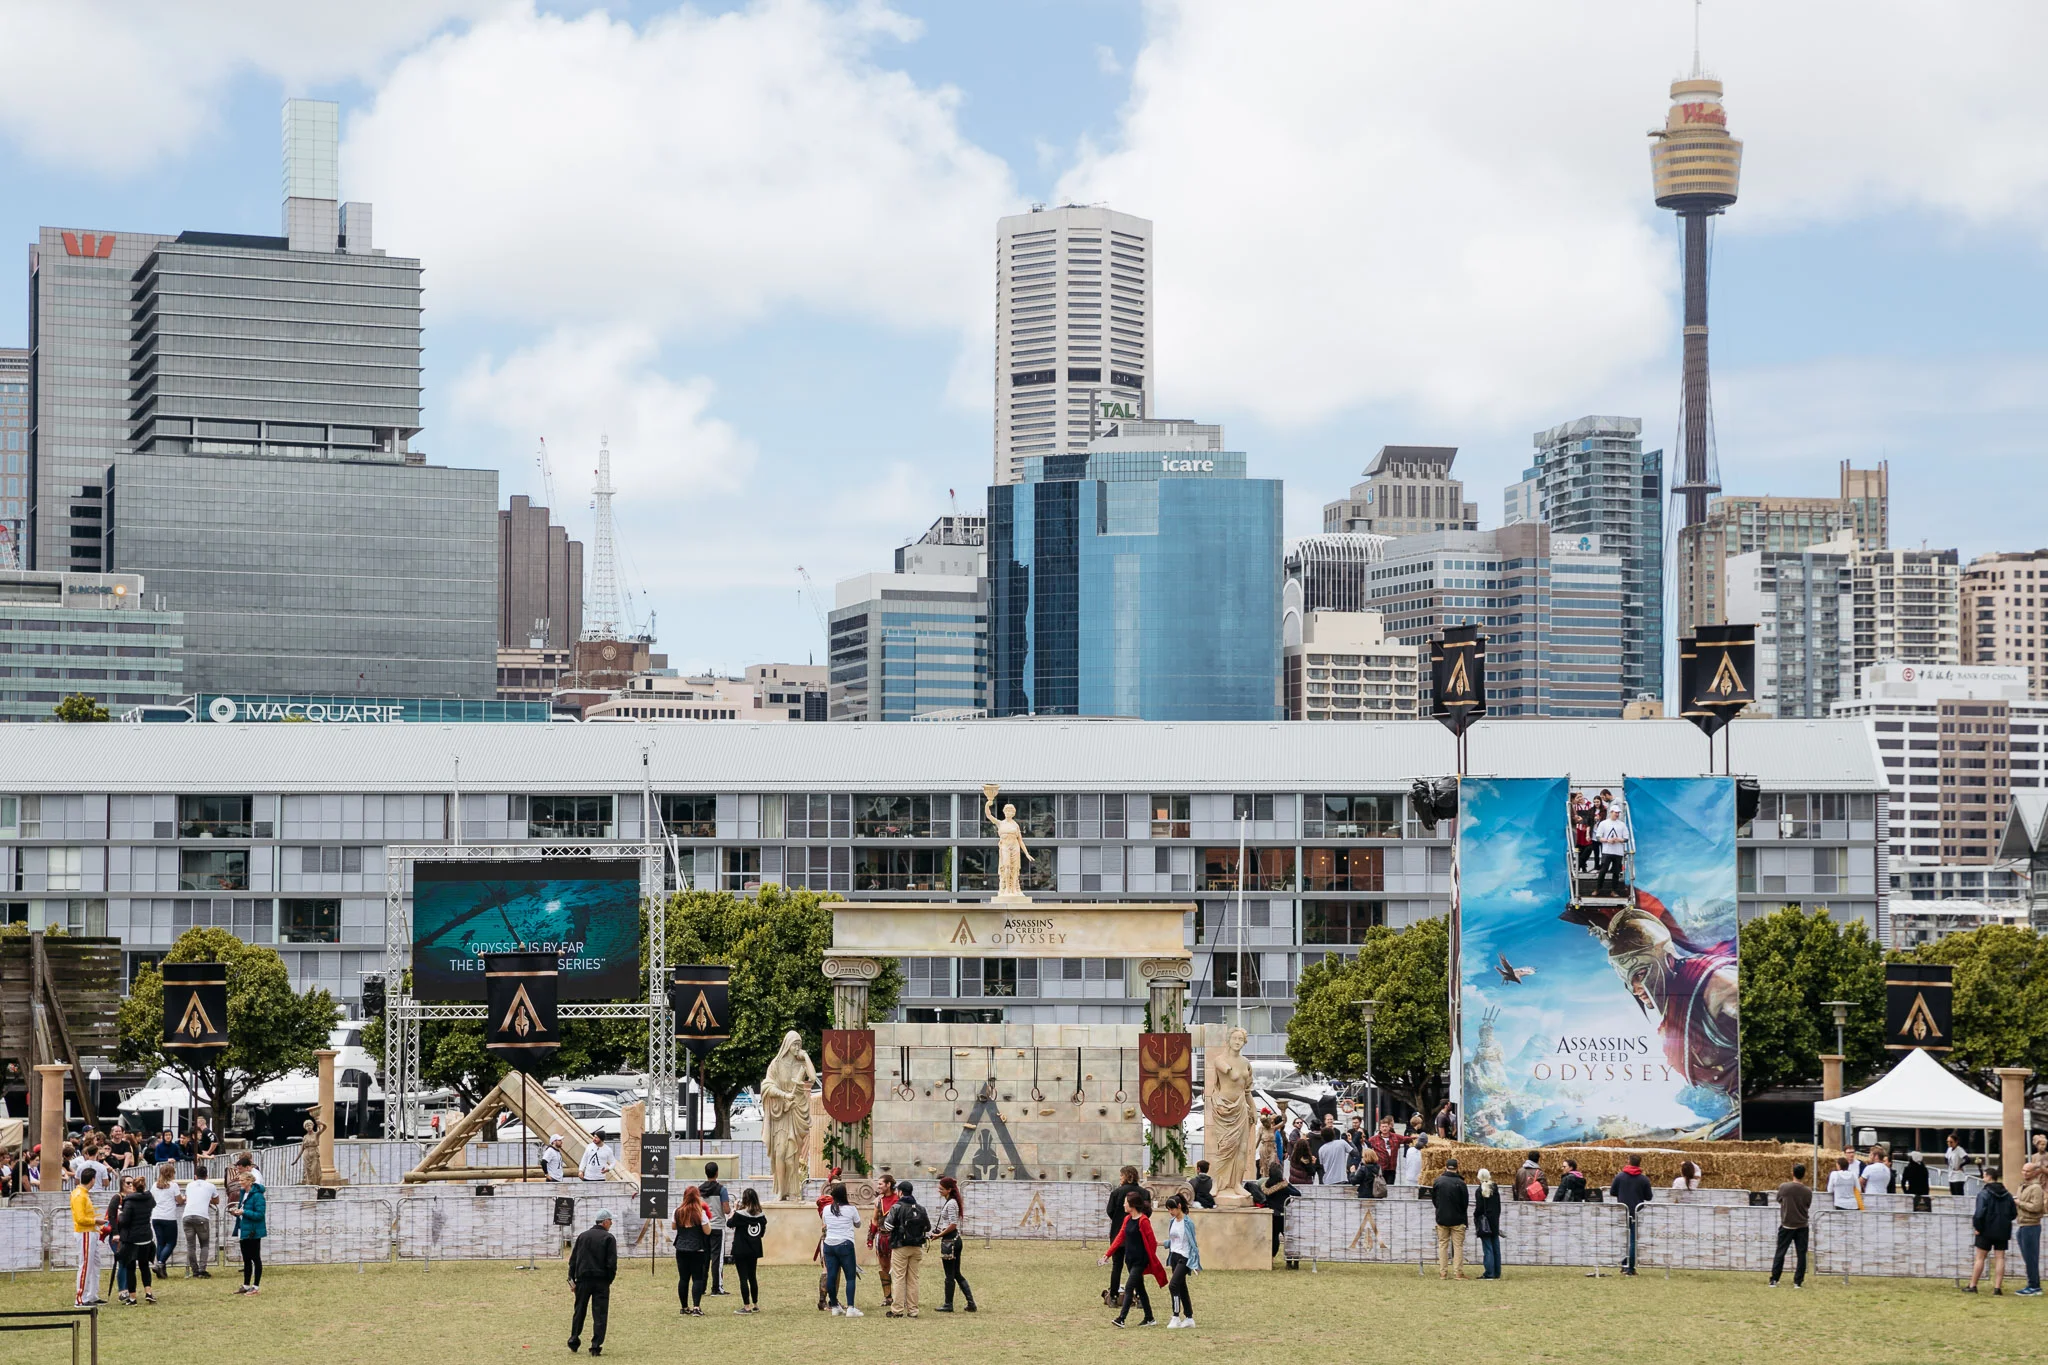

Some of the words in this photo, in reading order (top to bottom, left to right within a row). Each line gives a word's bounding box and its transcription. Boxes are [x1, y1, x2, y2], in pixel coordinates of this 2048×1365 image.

[1100, 402, 1136, 418] TAL
[1161, 455, 1214, 472] icare
[1552, 540, 1578, 550] ANZ
[1991, 672, 2017, 681] CHINA
[246, 703, 404, 723] MACQUARIE
[991, 933, 1067, 944] ODYSSEY
[528, 942, 539, 952] IS
[543, 942, 558, 952] BY
[561, 942, 584, 953] FAR
[449, 959, 473, 971] THE
[1578, 1052, 1629, 1062] CREED
[1534, 1063, 1675, 1081] ODYSSEY
